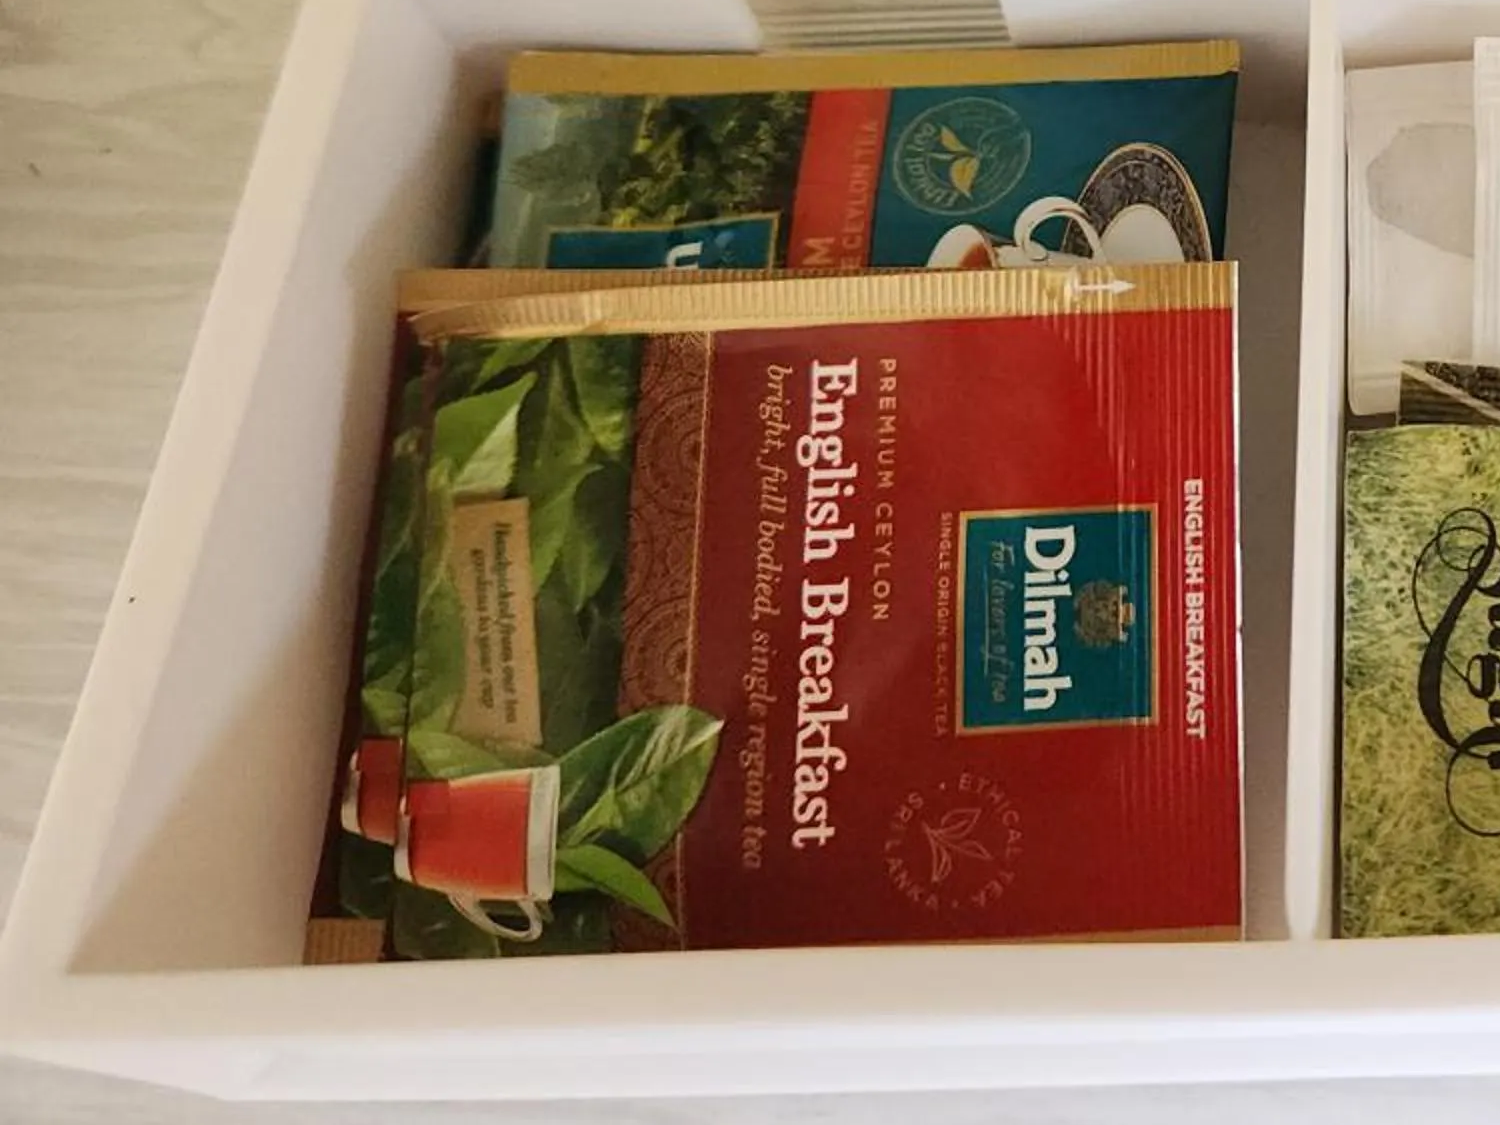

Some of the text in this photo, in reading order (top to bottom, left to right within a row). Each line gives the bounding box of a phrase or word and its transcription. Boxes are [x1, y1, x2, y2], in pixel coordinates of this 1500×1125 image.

[871, 357, 897, 621] PREMIUM CEYLON
[938, 511, 953, 571] SINGLE
[739, 364, 794, 870] bright, full bodied, single region tea
[790, 356, 859, 850] English Breakfast
[936, 575, 951, 636] ORIGIN
[1023, 524, 1076, 712] Dilmah
[1183, 477, 1206, 740] ENGLISH BREAKFAST
[957, 773, 1024, 860] ETHICAL
